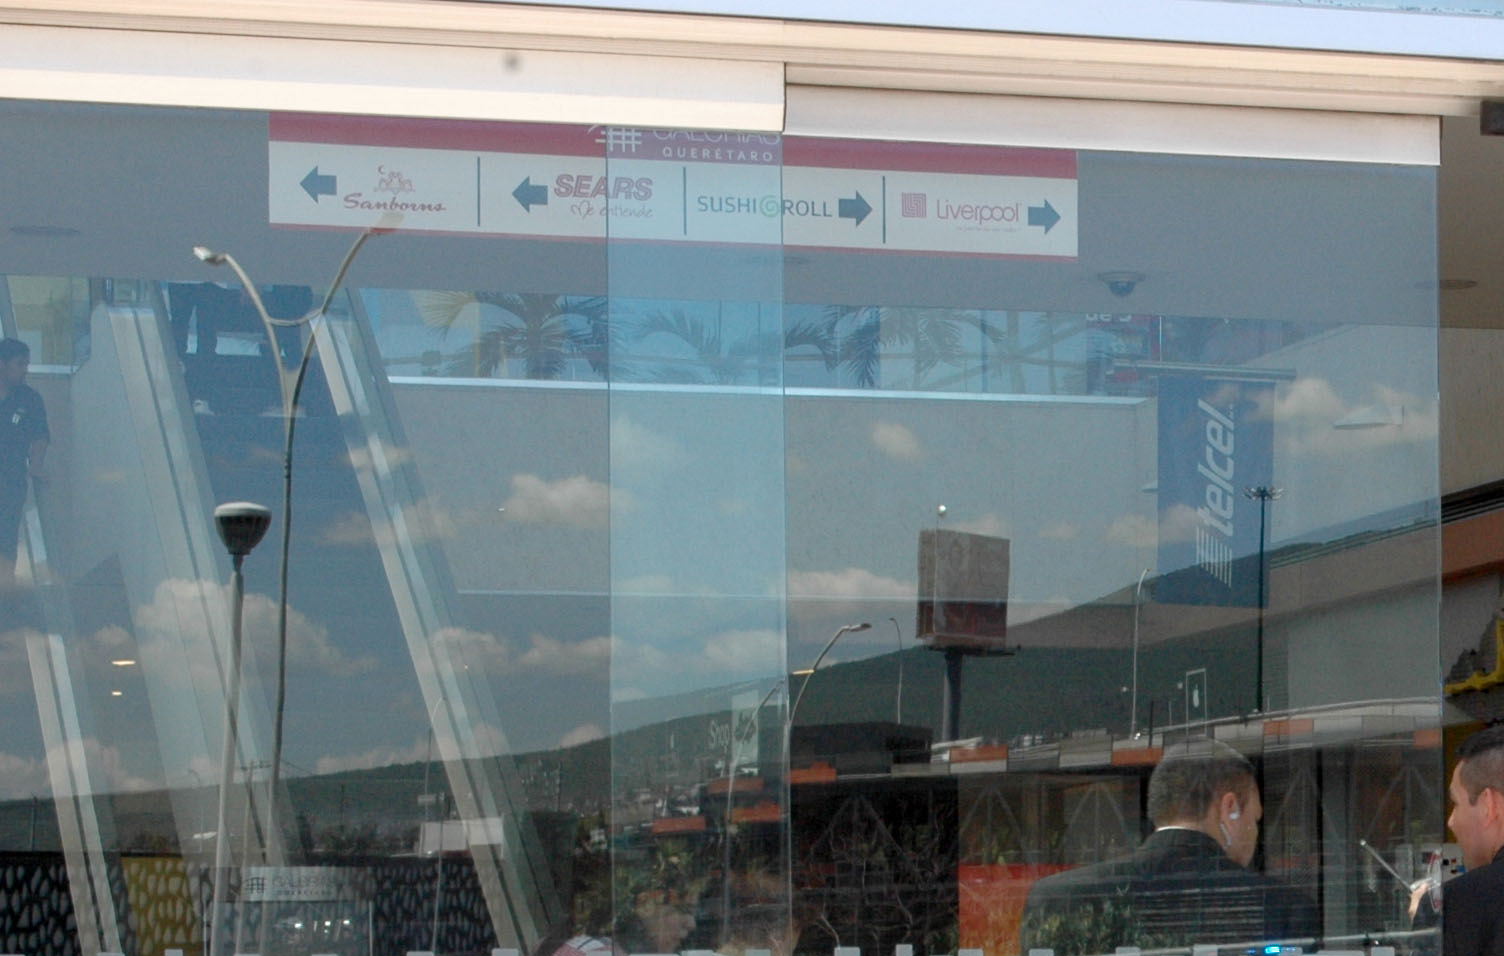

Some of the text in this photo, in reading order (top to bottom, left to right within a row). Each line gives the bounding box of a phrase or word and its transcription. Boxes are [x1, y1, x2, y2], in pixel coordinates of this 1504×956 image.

[662, 146, 774, 163] QUERÉTARO
[553, 173, 654, 201] SEARS
[342, 192, 448, 213] Sanborns
[697, 195, 833, 218] SUSHI ROLL
[936, 199, 1020, 225] Liverpool
[1197, 398, 1235, 537] telcel
